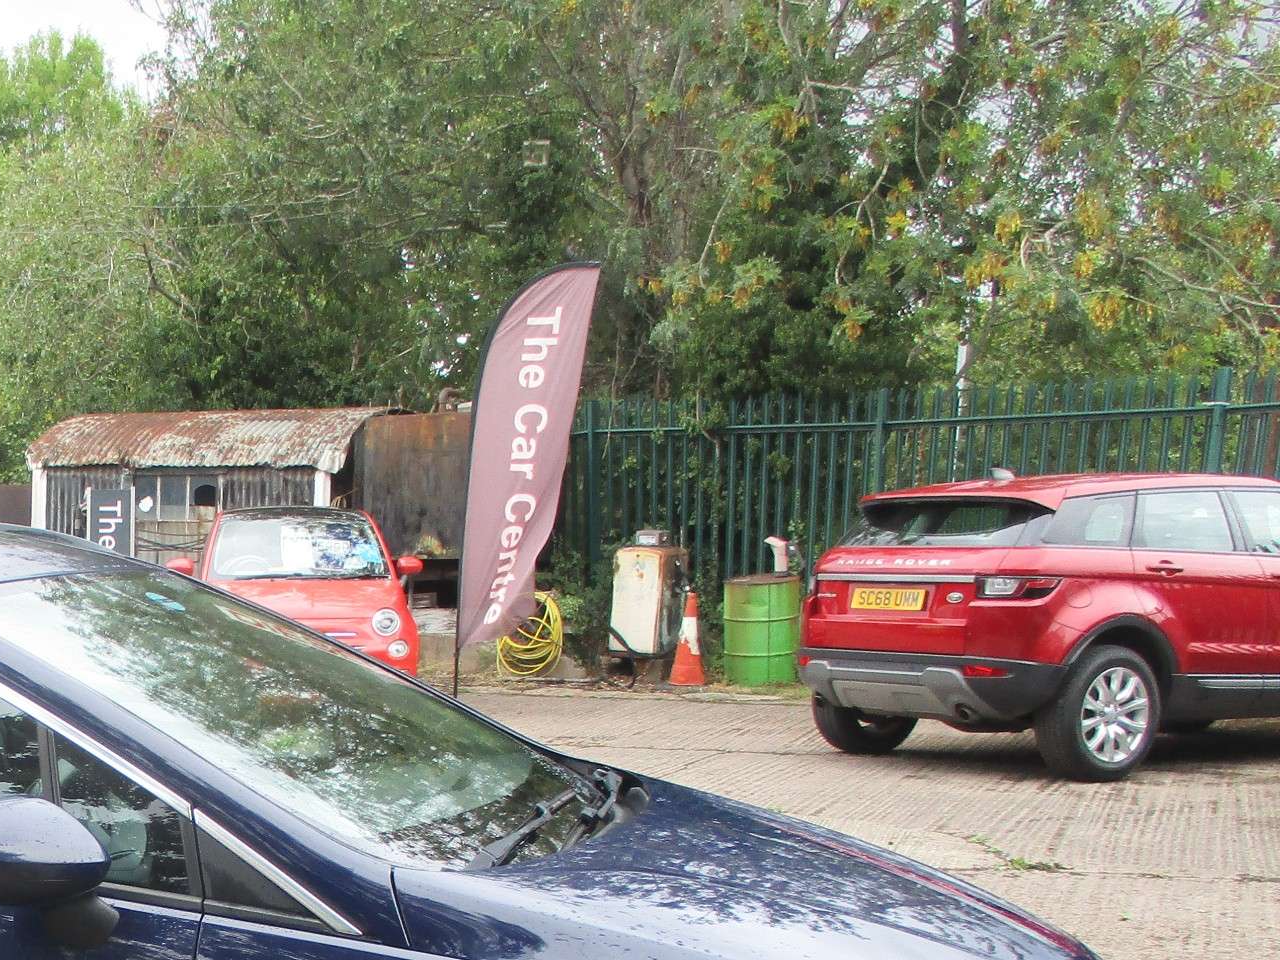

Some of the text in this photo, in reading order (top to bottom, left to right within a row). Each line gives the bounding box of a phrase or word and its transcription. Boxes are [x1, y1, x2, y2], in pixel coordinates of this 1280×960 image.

[483, 307, 564, 625] The Car Centre
[98, 500, 123, 550] The
[893, 558, 952, 566] ROVER
[858, 590, 892, 606] SC68
